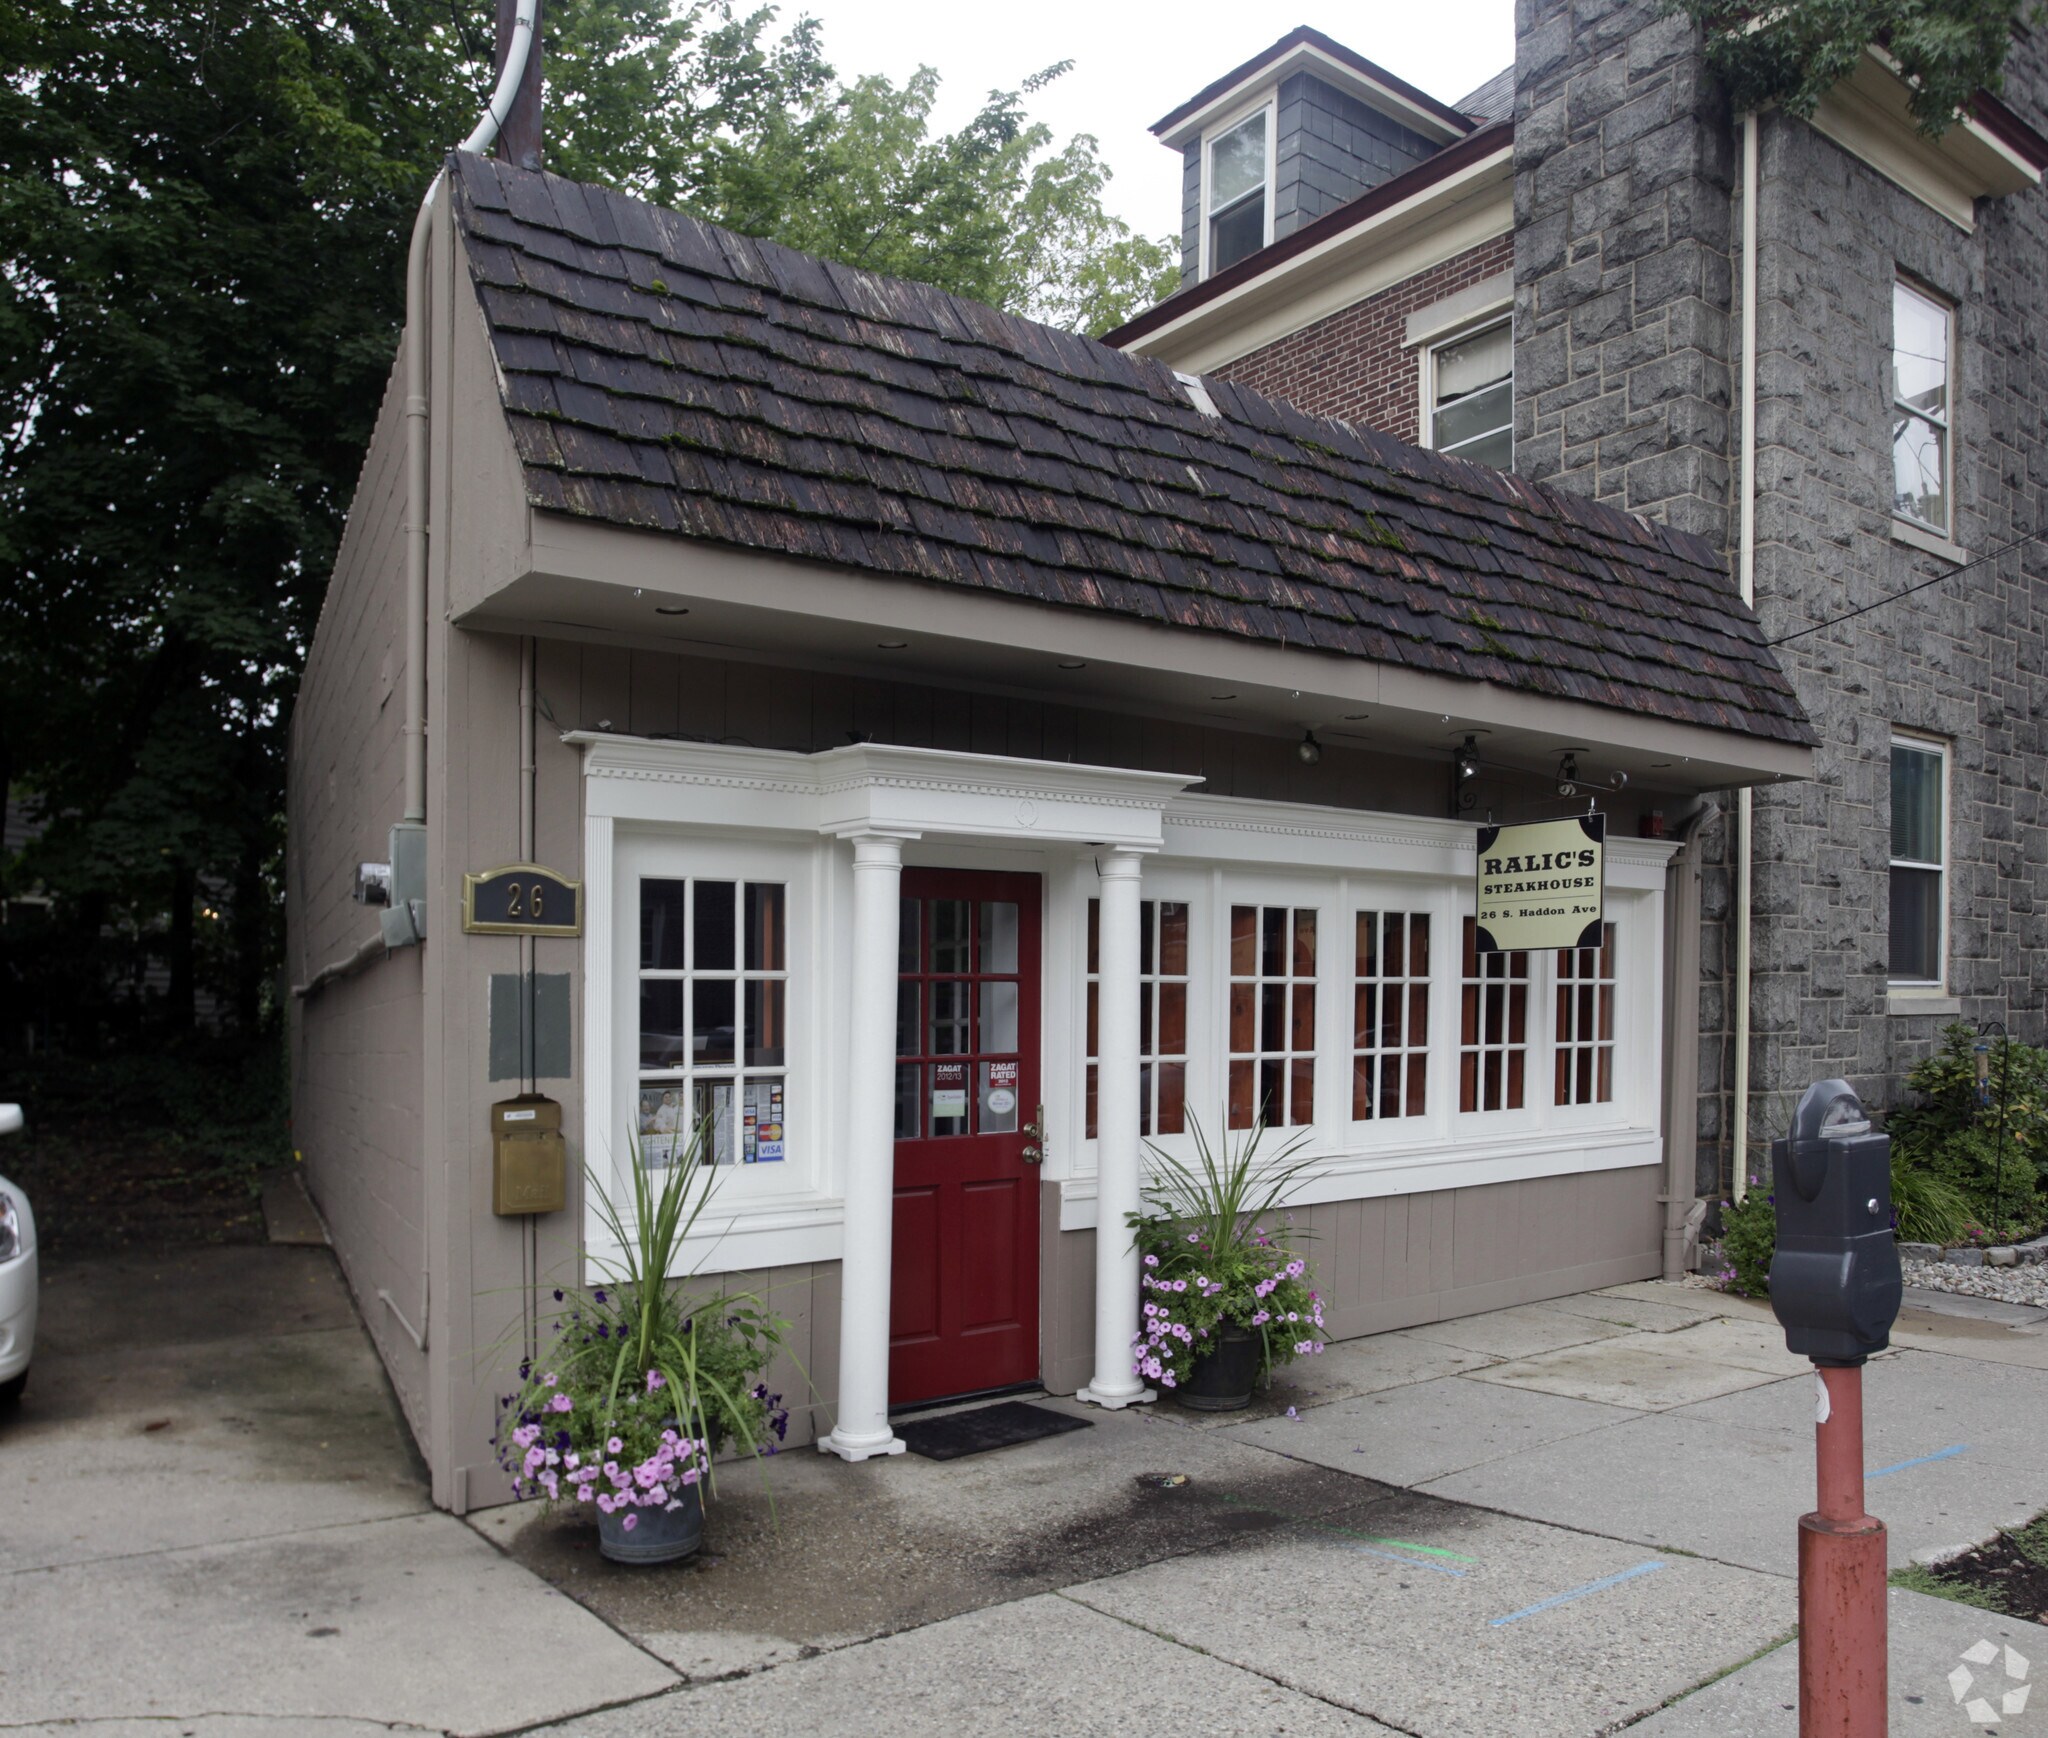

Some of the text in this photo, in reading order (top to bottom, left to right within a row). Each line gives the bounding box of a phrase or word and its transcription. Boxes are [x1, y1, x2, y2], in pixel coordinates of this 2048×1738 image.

[1484, 850, 1594, 876] RALIC'S
[1484, 877, 1594, 895] STEAKHOUSE
[507, 882, 544, 918] 26
[1481, 905, 1597, 919] 26 S. Haddon Ave
[937, 1064, 962, 1072] ZAGAT
[991, 1063, 1015, 1071] ZAGAT
[937, 1073, 962, 1081] 2012/13
[991, 1071, 1016, 1079] RATED
[761, 1145, 782, 1154] VISA
